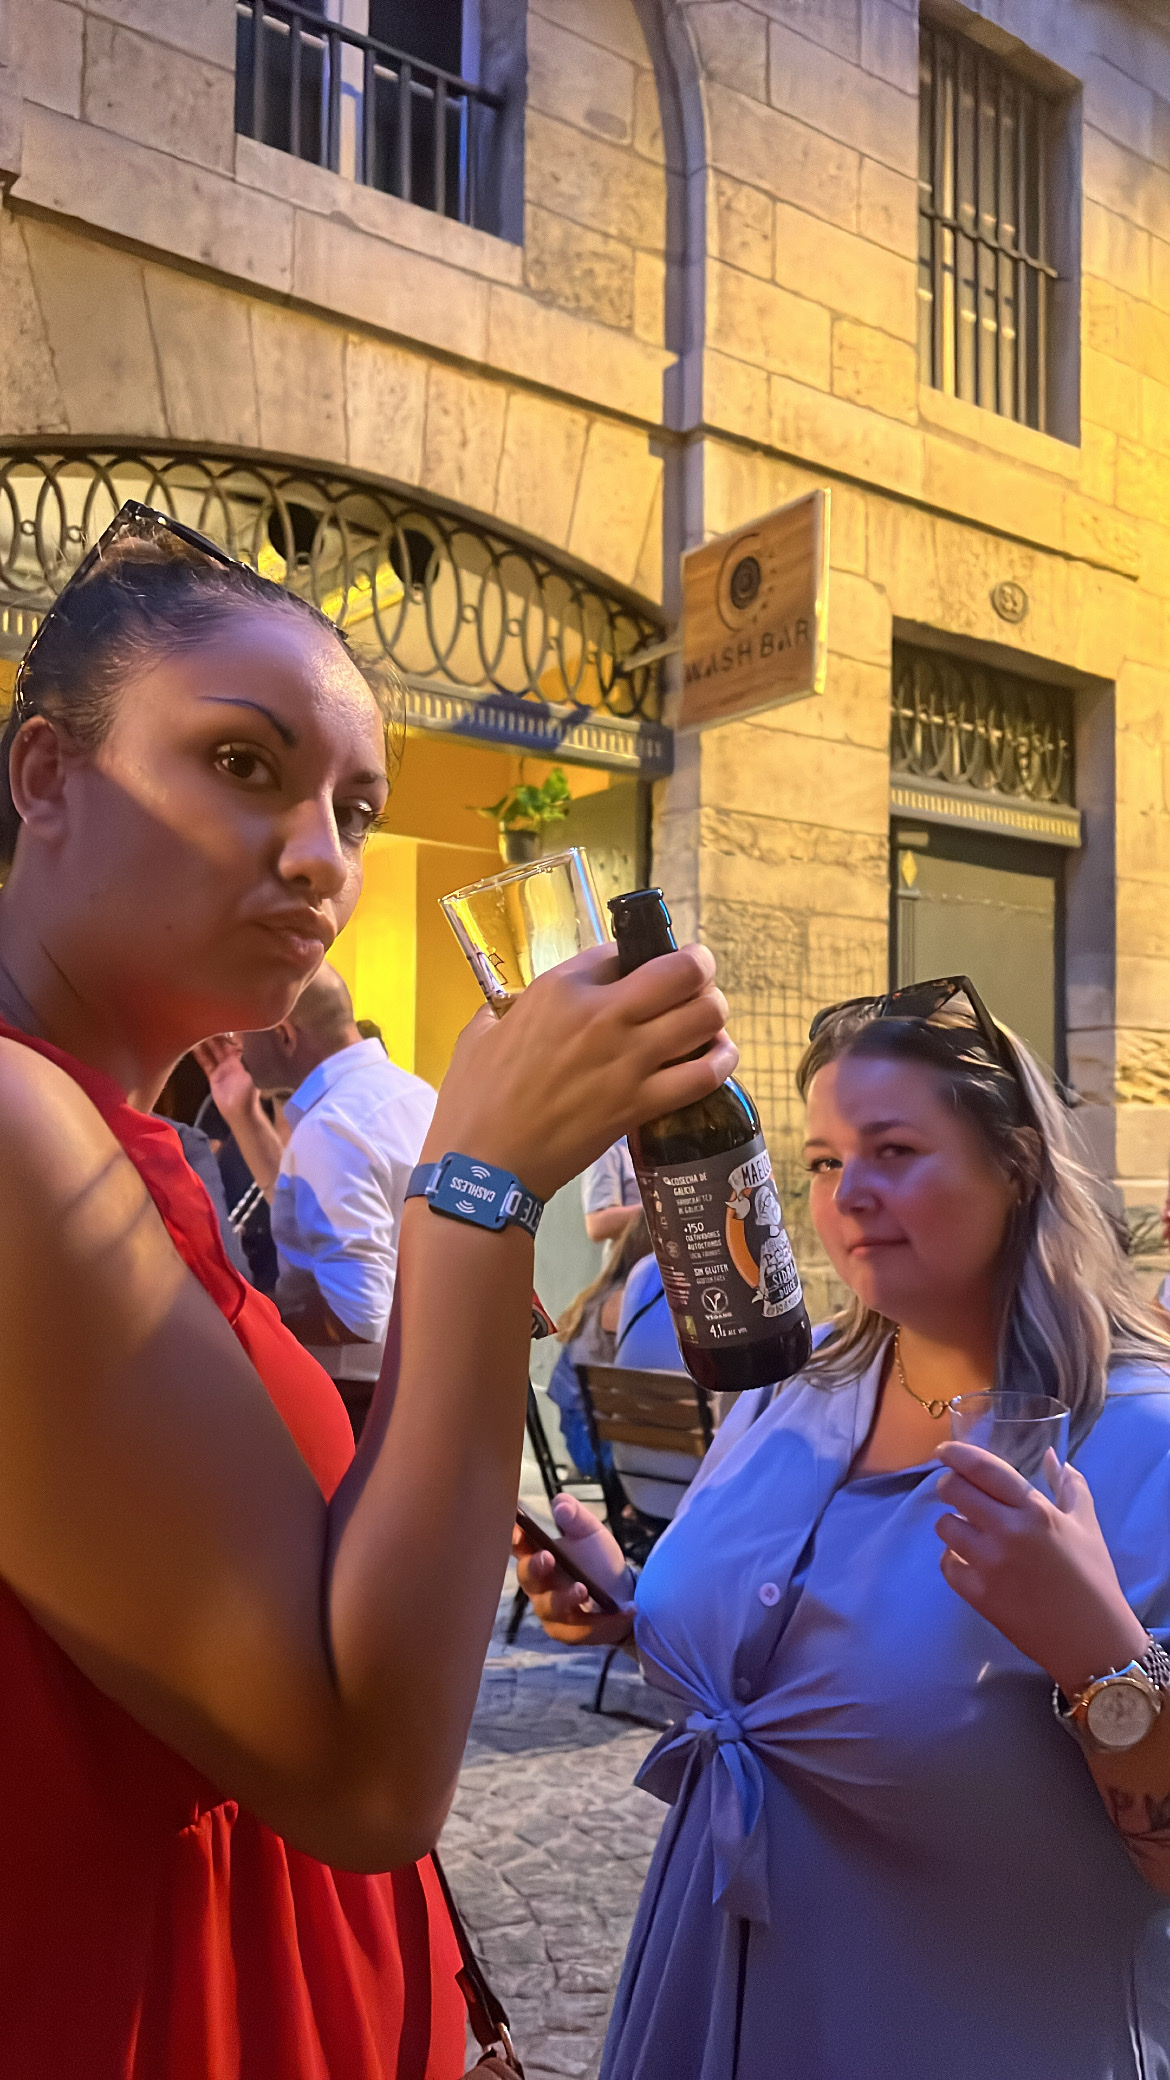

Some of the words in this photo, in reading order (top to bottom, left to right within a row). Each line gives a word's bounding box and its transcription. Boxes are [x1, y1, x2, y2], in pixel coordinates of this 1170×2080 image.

[685, 642, 753, 683] WASH
[760, 619, 809, 659] BAR
[741, 1154, 771, 1187] MAELO
[450, 1176, 496, 1203] CASHLESS
[704, 1264, 729, 1275] GLUTEN
